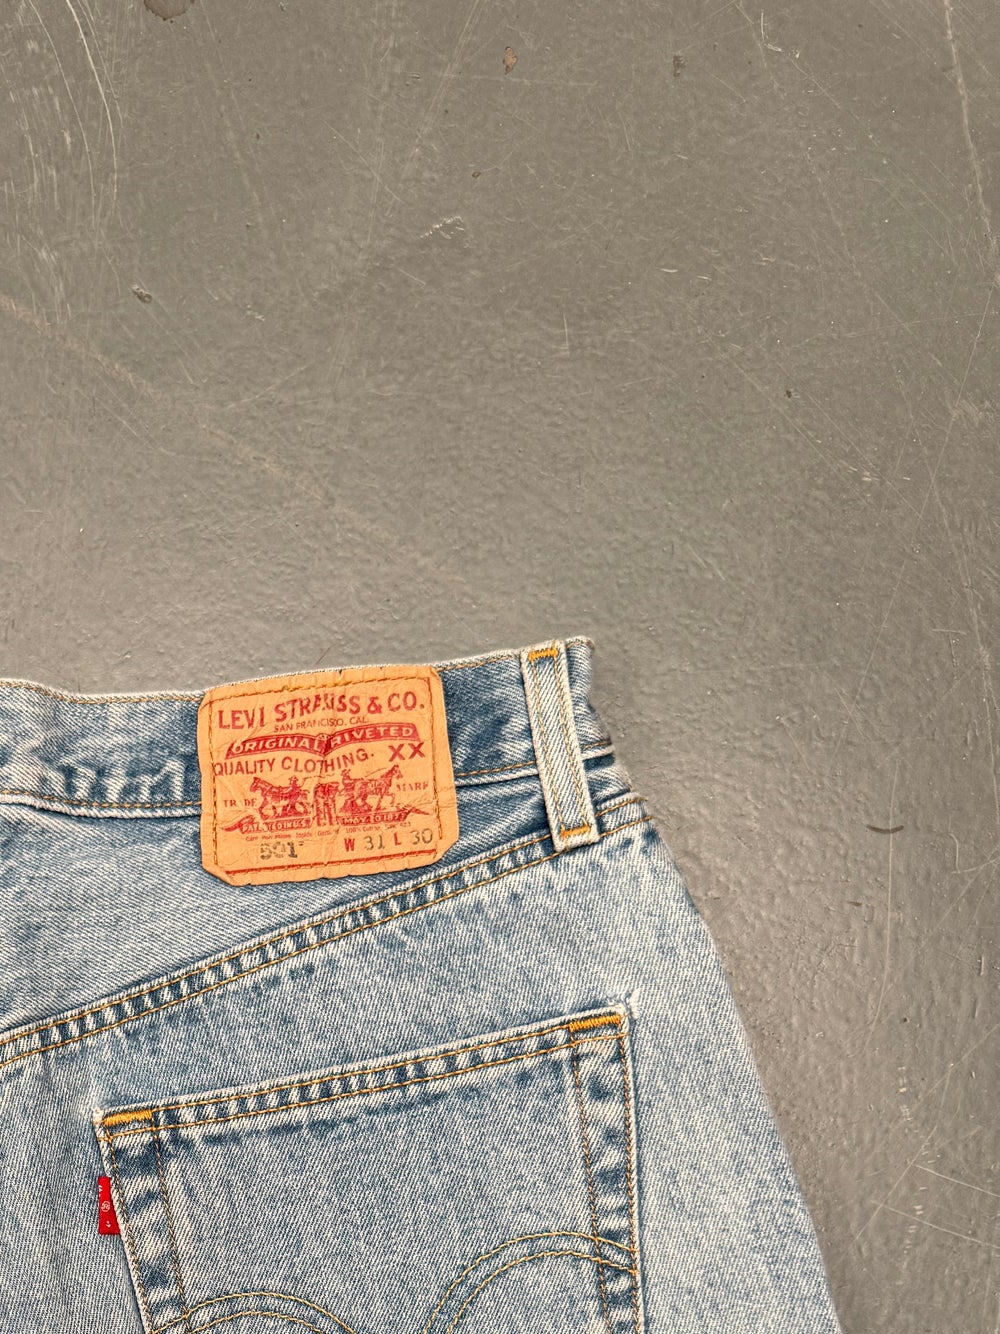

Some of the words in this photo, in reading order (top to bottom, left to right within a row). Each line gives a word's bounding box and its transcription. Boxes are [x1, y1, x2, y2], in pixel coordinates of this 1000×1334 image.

[217, 706, 266, 730] LEVI
[274, 693, 361, 723] STRAUSS
[366, 696, 383, 714] &
[387, 690, 425, 712] CO.
[231, 736, 323, 755] ORIGINAL
[330, 726, 415, 748] RIVETED
[273, 722, 294, 734] SAN
[213, 758, 276, 777] QUALITY
[388, 742, 426, 762] XX
[223, 798, 257, 808] TRDE
[344, 837, 355, 852] W
[363, 834, 385, 851] 31
[393, 832, 402, 846] L
[409, 828, 434, 845] 30
